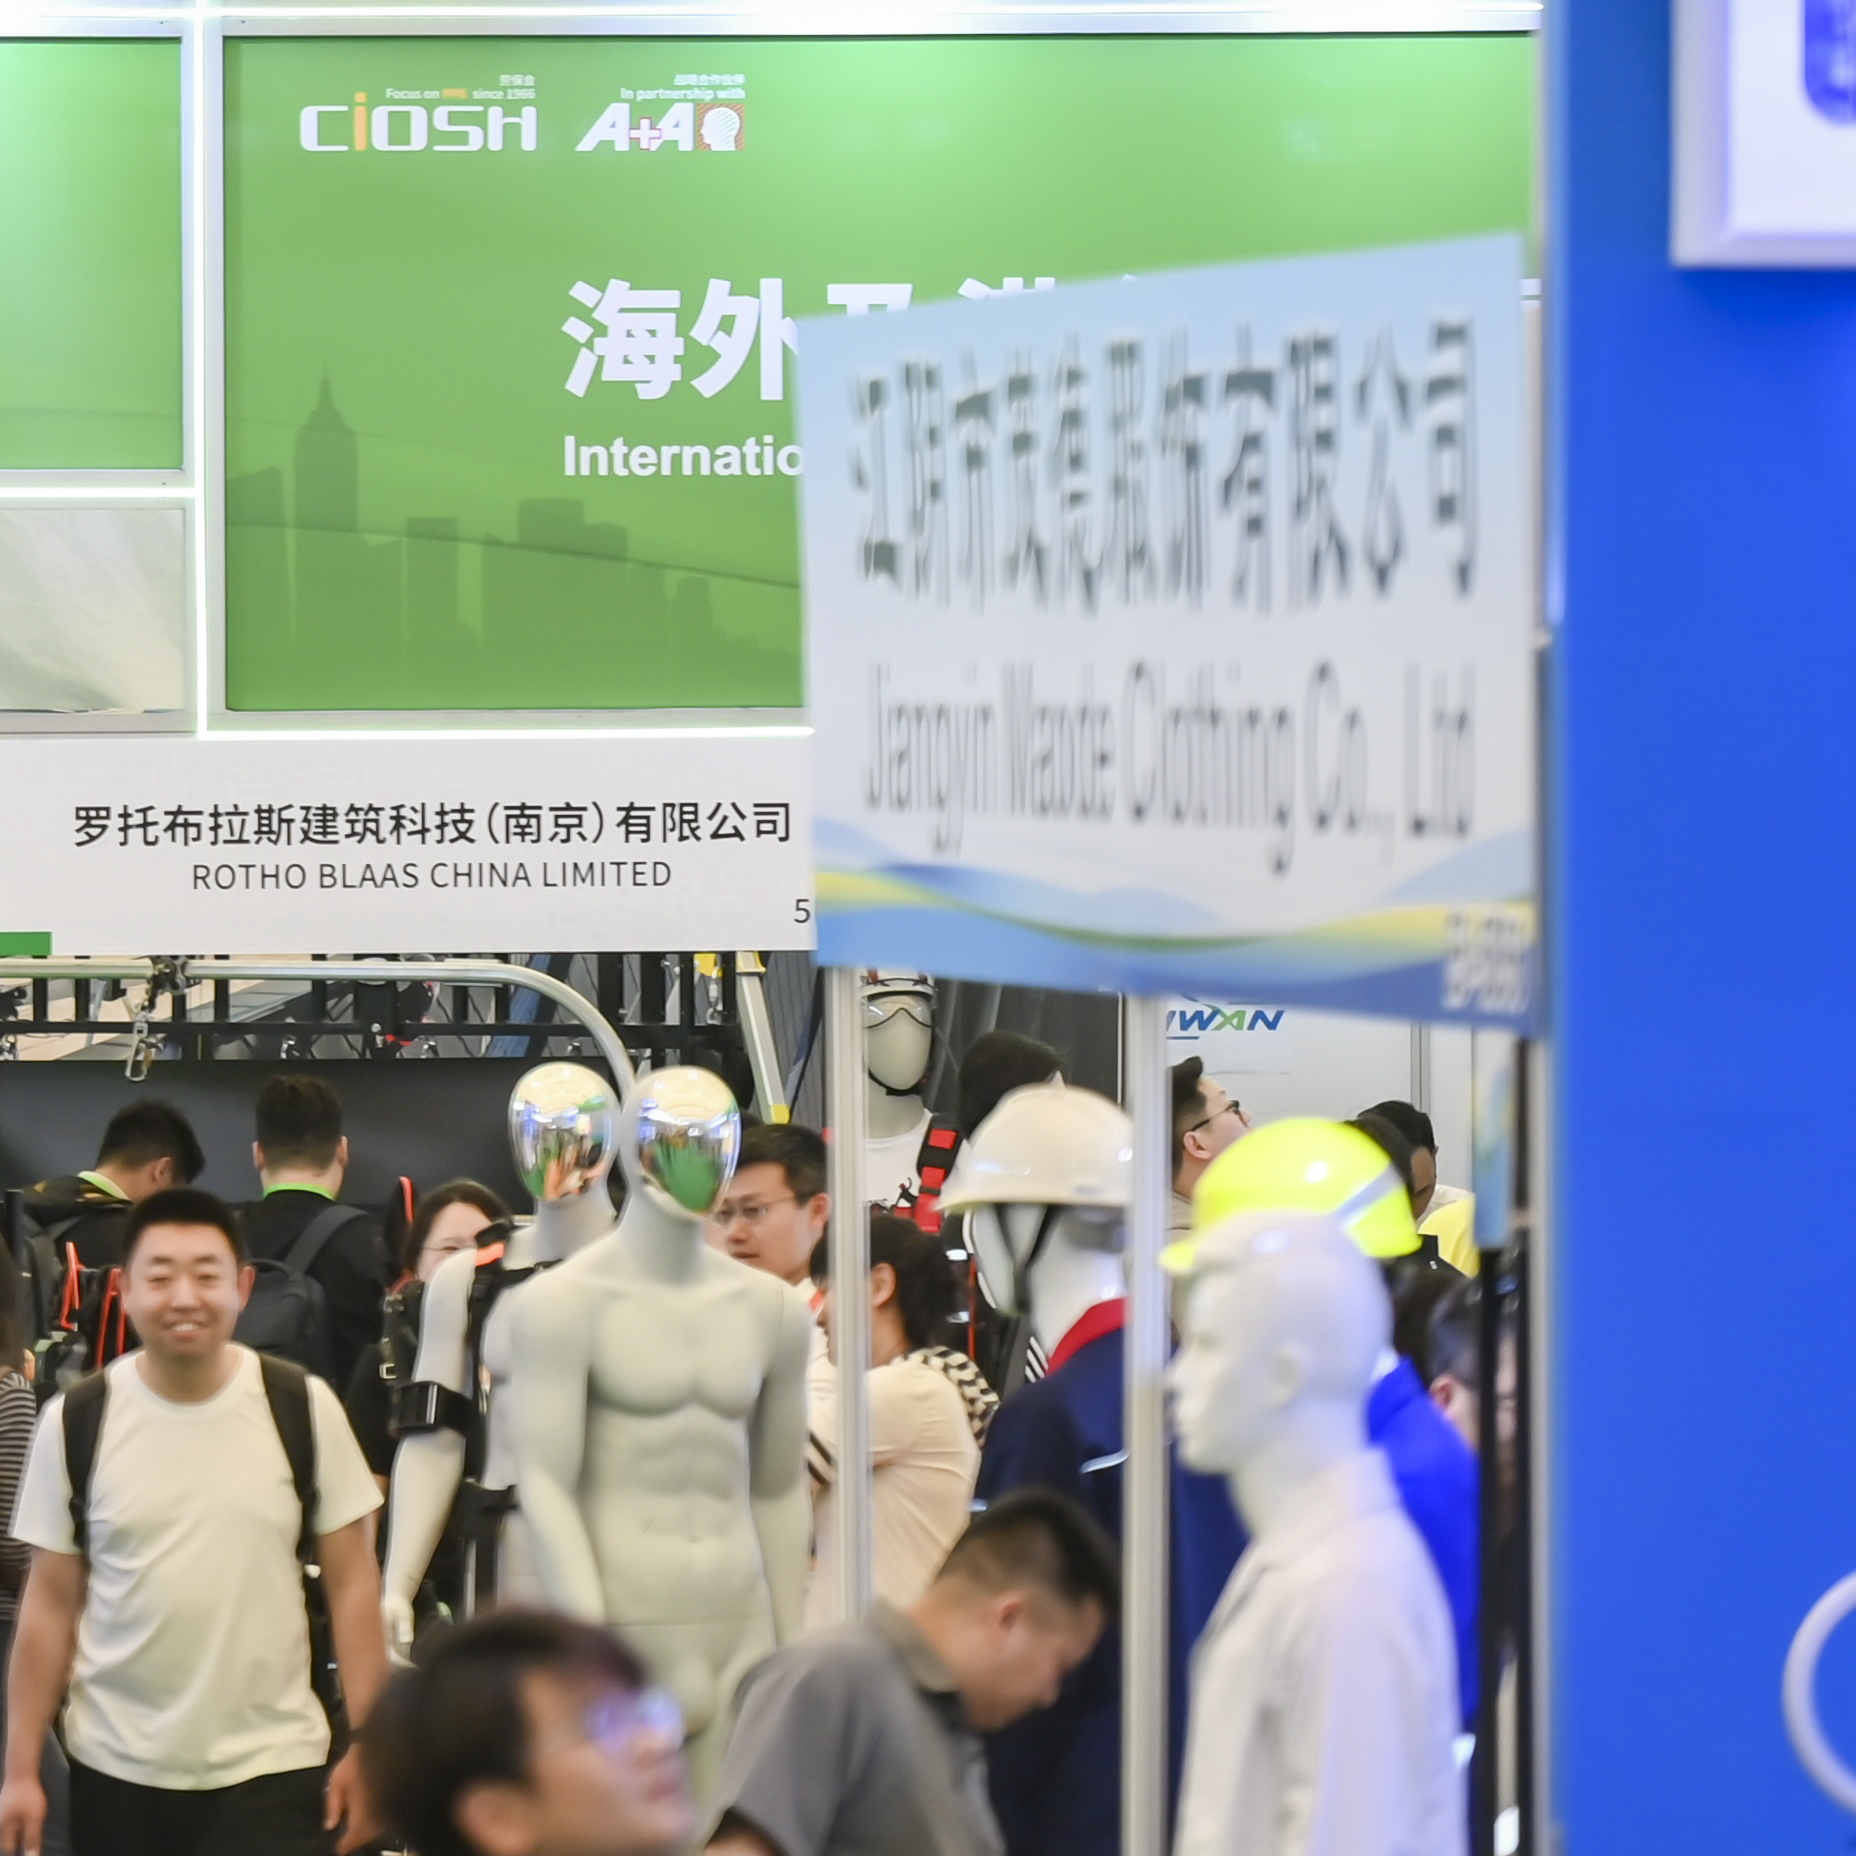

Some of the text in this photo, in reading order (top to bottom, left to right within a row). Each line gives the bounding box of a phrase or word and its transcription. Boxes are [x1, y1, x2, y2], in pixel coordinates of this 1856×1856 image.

[574, 101, 694, 152] A+A
[193, 860, 673, 891] ROTHO BLAAS CHINA LIMITED
